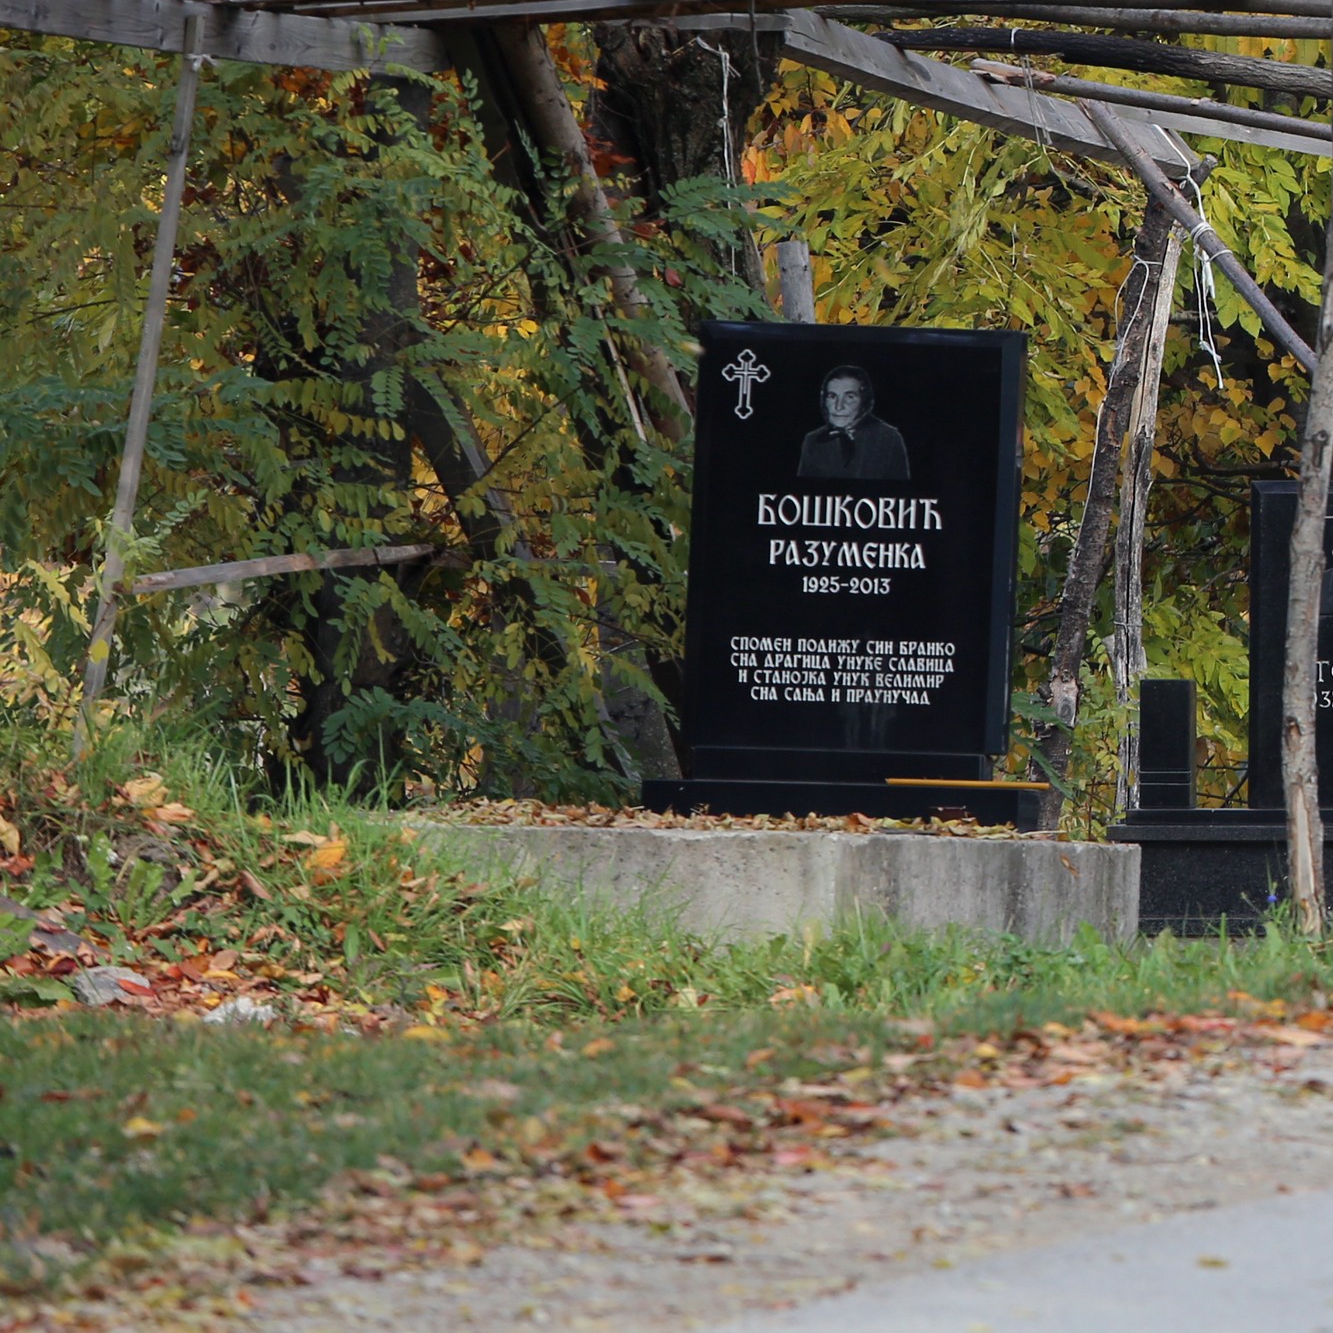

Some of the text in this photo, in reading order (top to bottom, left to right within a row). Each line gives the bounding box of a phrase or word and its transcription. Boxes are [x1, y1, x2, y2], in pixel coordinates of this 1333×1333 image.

[757, 494, 943, 530] БОШКОВИЋ
[769, 539, 927, 569] РАЗУМЕНКА
[802, 576, 892, 594] 1925-2013
[730, 636, 956, 656] СПОМЕН ПОДИЖУ СИН БРАНКО
[730, 652, 955, 673] СНА ДРАГИЦА УНУКЕ СЛАВИЦА
[738, 669, 945, 689] И СТАНОЈКА УНУК ВЕЛИМИР
[750, 686, 931, 705] СНА САЊА И ПРАУНУЧАД
